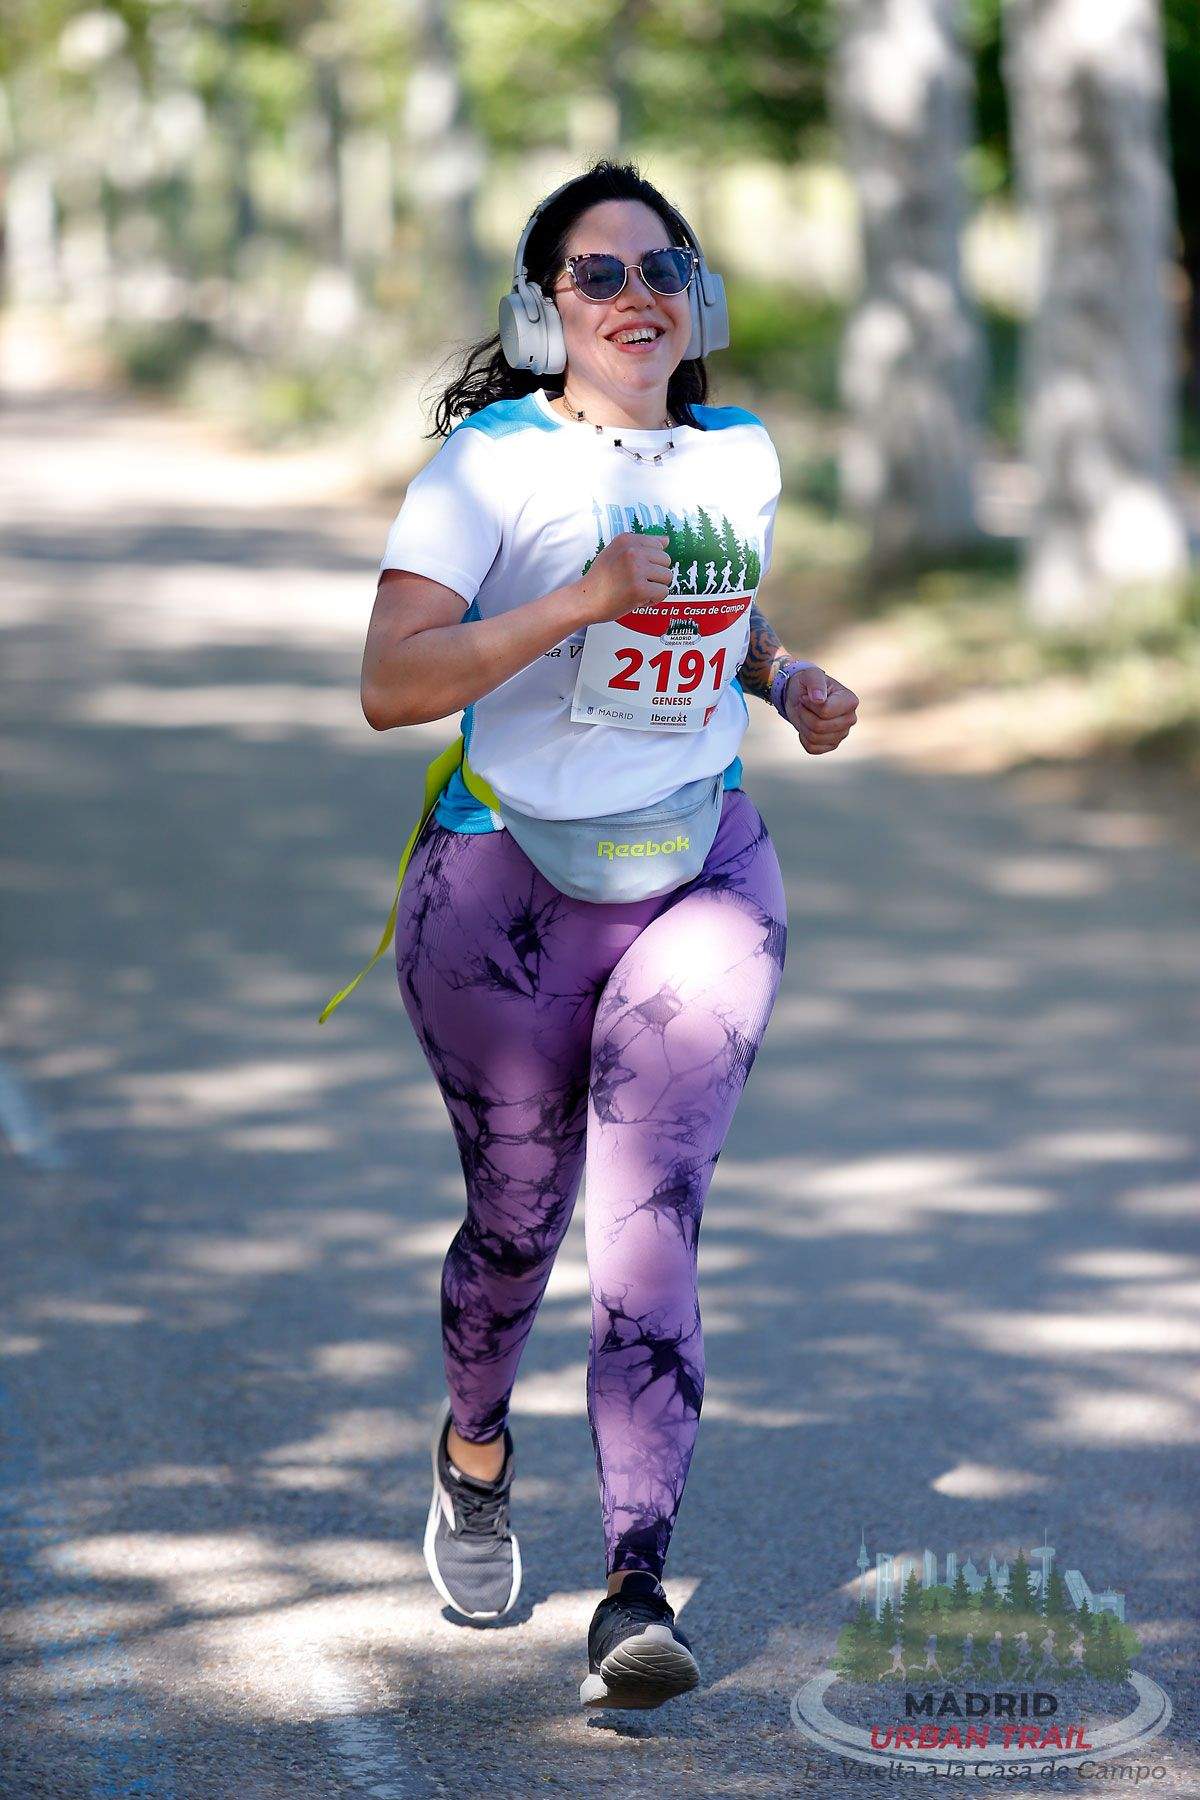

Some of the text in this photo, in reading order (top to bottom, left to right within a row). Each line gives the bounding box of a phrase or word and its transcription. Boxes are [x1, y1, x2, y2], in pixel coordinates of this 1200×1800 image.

[631, 606, 659, 615] uelta
[670, 606, 680, 615] la
[683, 606, 707, 615] Casa
[708, 606, 719, 615] de
[720, 603, 745, 614] Campo
[607, 647, 727, 693] 2191
[651, 696, 692, 706] GENESIS
[598, 708, 634, 721] MADRID
[650, 712, 688, 723] Iberext
[597, 835, 690, 863] Reebok
